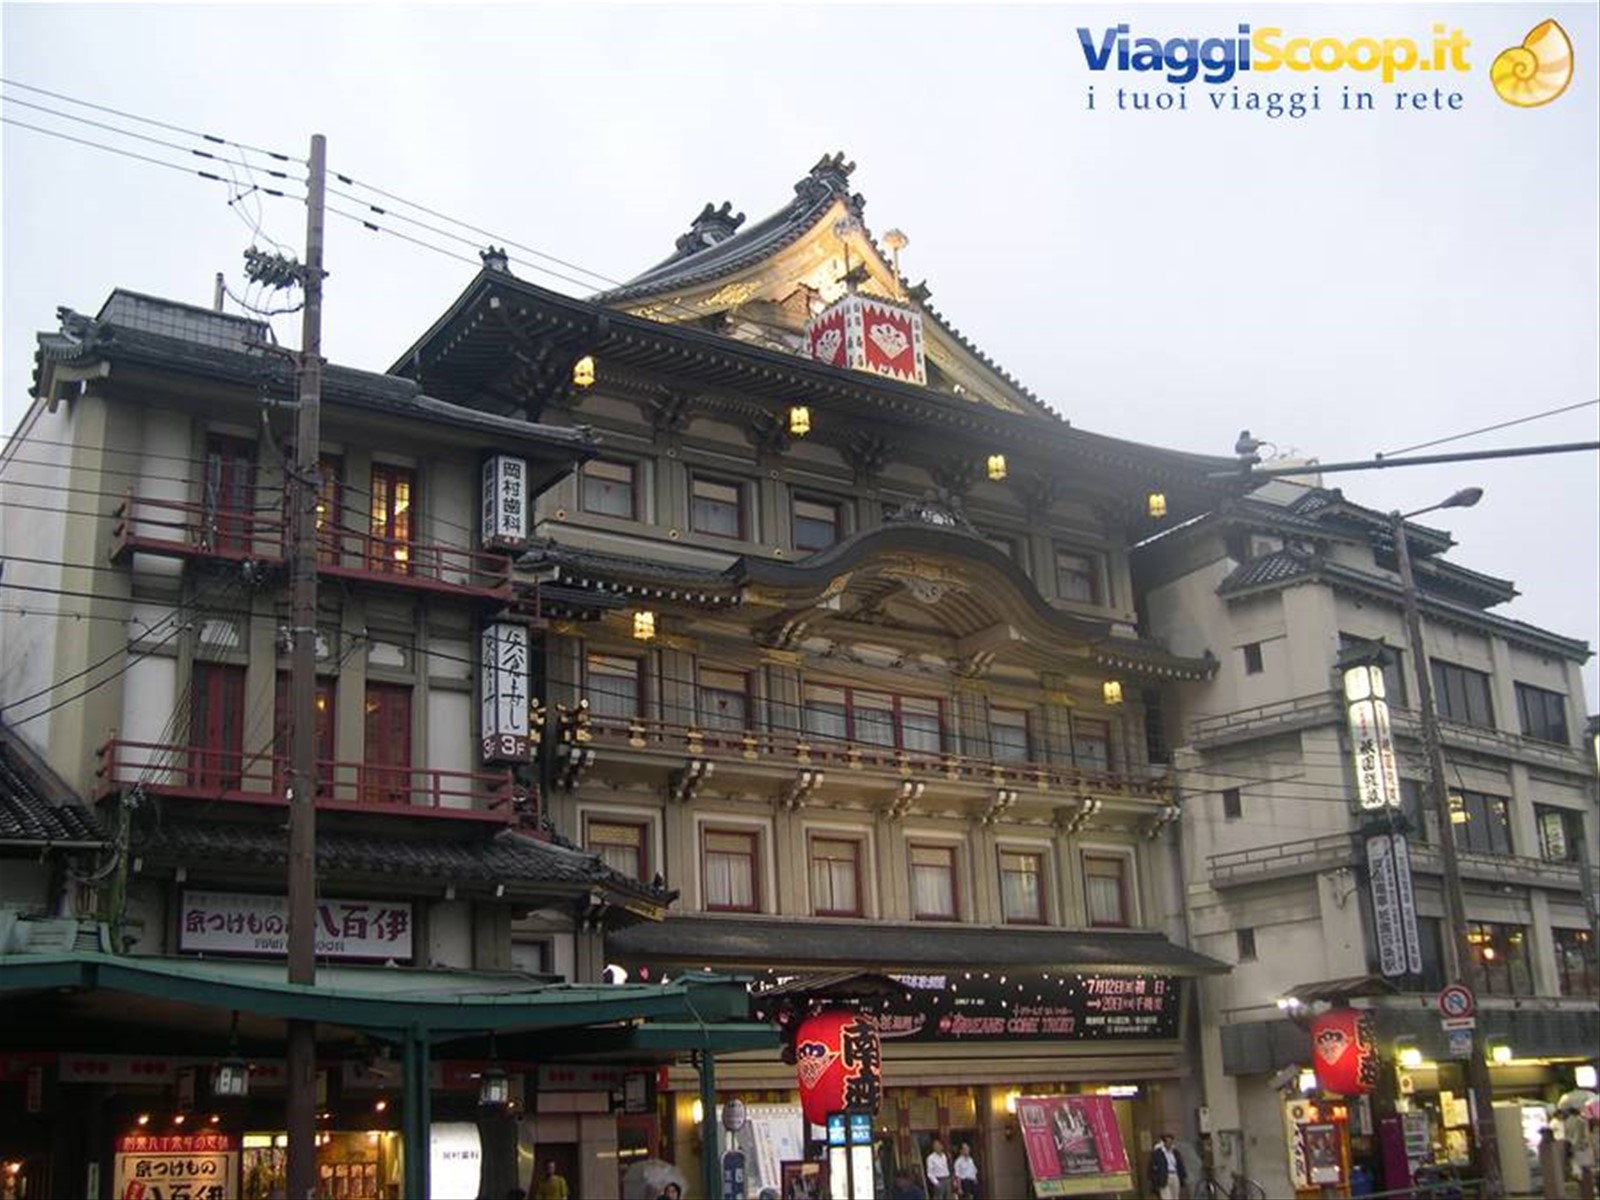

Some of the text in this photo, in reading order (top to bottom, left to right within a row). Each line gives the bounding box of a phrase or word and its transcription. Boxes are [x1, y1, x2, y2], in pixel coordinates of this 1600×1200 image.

[503, 461, 521, 532] 岡村歯科
[501, 735, 526, 756] 3F
